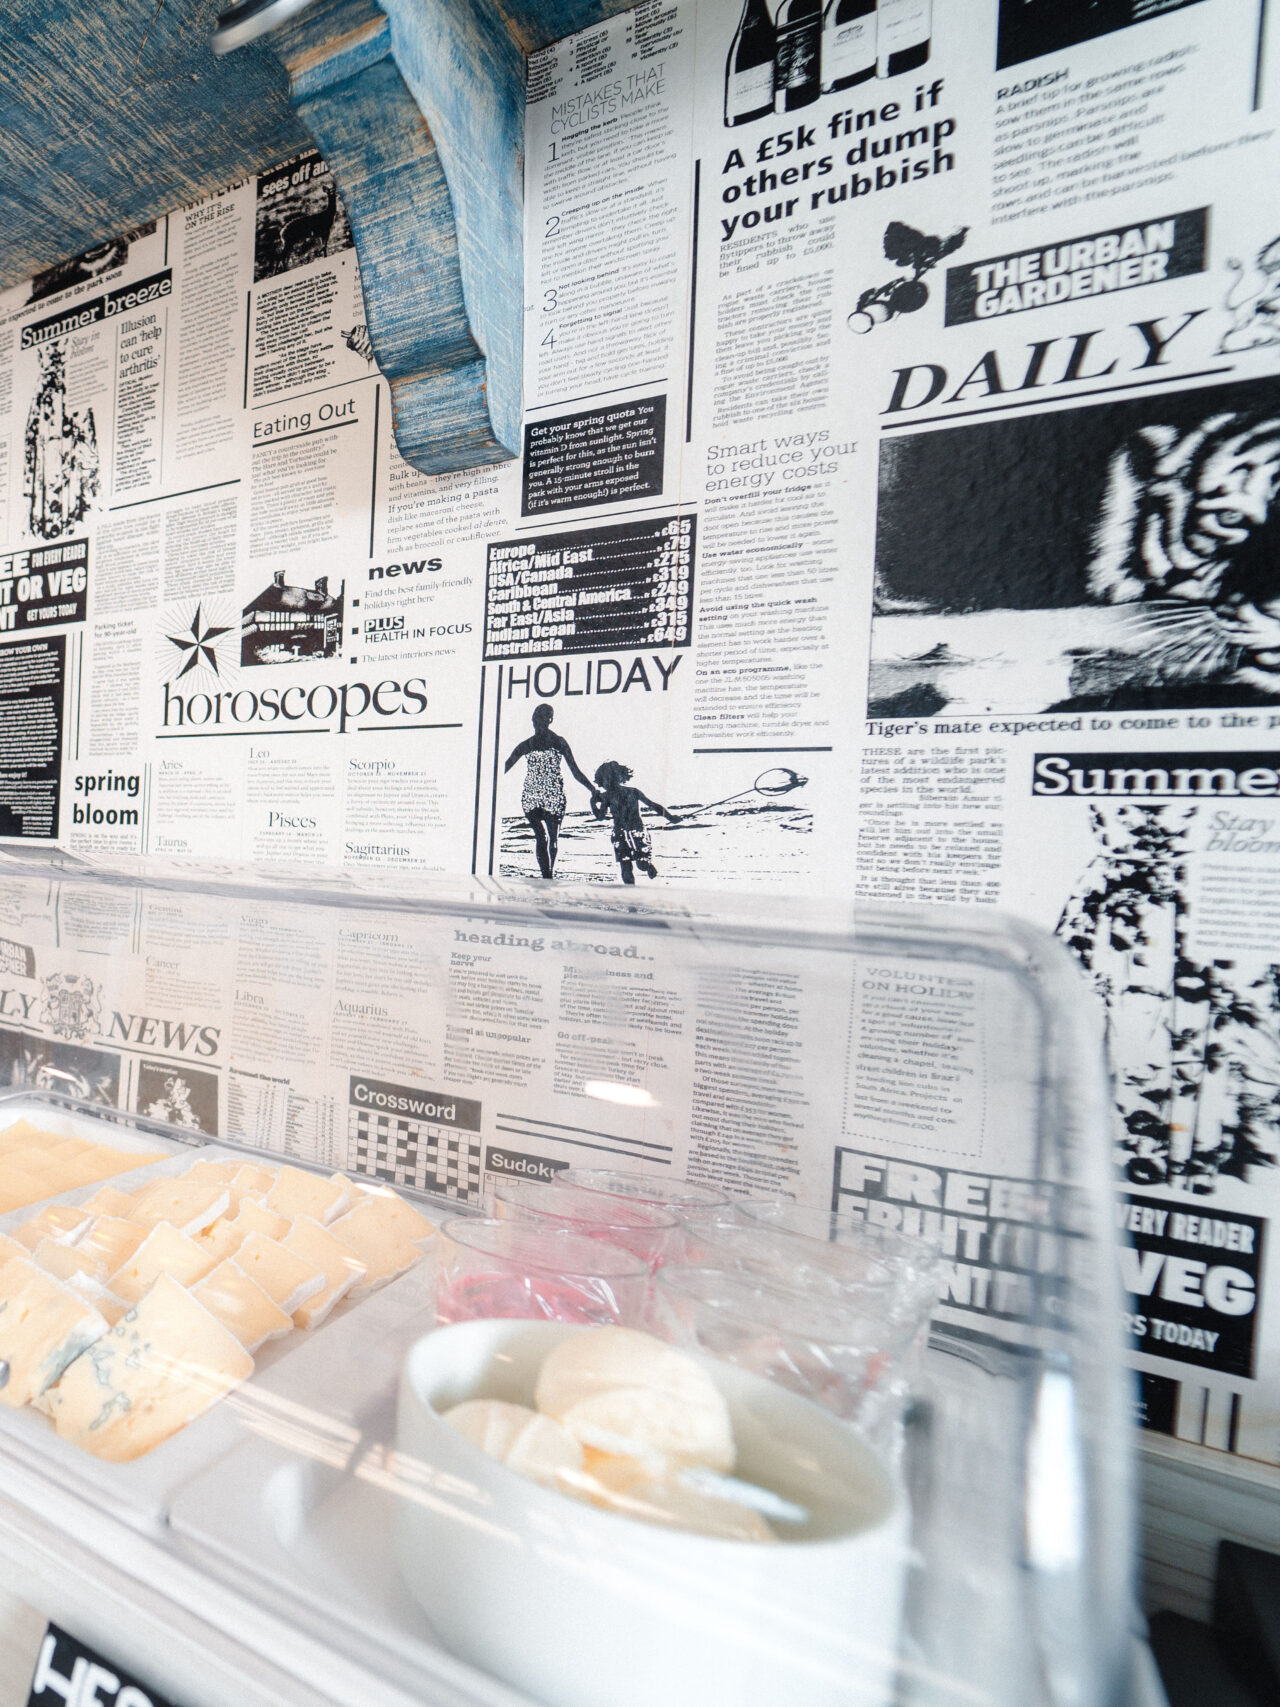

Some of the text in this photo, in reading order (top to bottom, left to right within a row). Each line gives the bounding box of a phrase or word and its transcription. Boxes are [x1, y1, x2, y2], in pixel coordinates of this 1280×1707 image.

[552, 63, 666, 120] MISTAKES THAT
[996, 67, 1070, 100] RADISH
[551, 79, 665, 134] CYCLISTS MAKE
[722, 79, 944, 174] A £5k fine if
[548, 142, 560, 163] 1
[722, 118, 956, 203] others dump
[263, 163, 311, 198] sees off
[721, 198, 799, 242] your
[811, 149, 954, 210] rubbish
[545, 216, 561, 238] 2
[972, 220, 1176, 293] THE URBAN
[975, 252, 1170, 318] GARDENER
[21, 278, 171, 348] Summer breeze
[543, 289, 558, 312] 3
[121, 313, 156, 335] Illusion
[541, 328, 557, 349] 4
[120, 335, 137, 348] can
[120, 344, 154, 364] to cure
[880, 308, 1210, 415] DAILY
[253, 399, 357, 439] Eating Out
[530, 432, 564, 448] probably
[565, 431, 586, 440] know
[588, 427, 603, 435] that
[618, 422, 632, 431] get
[633, 418, 648, 426] our
[531, 406, 654, 437] Get your spring quota You
[530, 446, 559, 457] vitamin
[569, 441, 588, 450] from
[626, 428, 654, 439] Spring
[707, 430, 830, 460] Smart ways
[707, 441, 858, 476] to reduce your
[706, 462, 838, 491] energy costs
[388, 505, 395, 513] If
[428, 494, 462, 508] making
[473, 487, 499, 500] pasta
[490, 520, 691, 560] Europe £65
[563, 549, 594, 564] East
[664, 536, 691, 550] £79
[32, 552, 43, 568] FOR
[44, 547, 62, 566] EVERY
[63, 543, 86, 562] READER
[369, 558, 443, 580] news
[488, 550, 690, 588] USA/Canada £275
[17, 575, 43, 602] OR
[48, 567, 86, 597] VEG
[488, 565, 689, 602] Caribbean £319
[488, 581, 689, 616] South & Central America £249
[27, 609, 38, 621] GET
[39, 606, 57, 620] YOURS
[58, 603, 77, 617] TODAY
[365, 617, 404, 632] PLUS
[487, 615, 508, 629] Far
[649, 596, 688, 613] £349
[365, 624, 472, 643] HEALTH IN FOCUS
[485, 626, 687, 657] Australasia £649
[487, 628, 529, 642] Indian
[532, 623, 575, 638] Ocean
[508, 655, 683, 698] HOLIDAY
[161, 678, 428, 733] horoscopes
[865, 720, 928, 737] Tiger's
[934, 720, 983, 734] mate
[989, 718, 1082, 735] expected
[1091, 719, 1111, 730] to
[1121, 717, 1179, 730] come
[1188, 714, 1211, 728] to
[1220, 712, 1258, 727] the
[249, 748, 270, 759] Leo
[349, 759, 396, 774] Scorpio
[75, 770, 140, 797] spring
[1035, 757, 1280, 796] Summe
[73, 803, 139, 825] bloom
[268, 811, 317, 829] Pisces
[344, 842, 410, 857] Sagittarius
[338, 929, 399, 942] Capricorn
[454, 930, 545, 951] heading
[236, 990, 264, 1005] Libra
[334, 1000, 388, 1016] Aquarius
[108, 1011, 221, 1057] NEWS
[352, 1083, 457, 1121] Crossword
[1169, 1212, 1255, 1254] READER
[1119, 1246, 1256, 1316] VEG
[1151, 1318, 1220, 1352] TODAY
